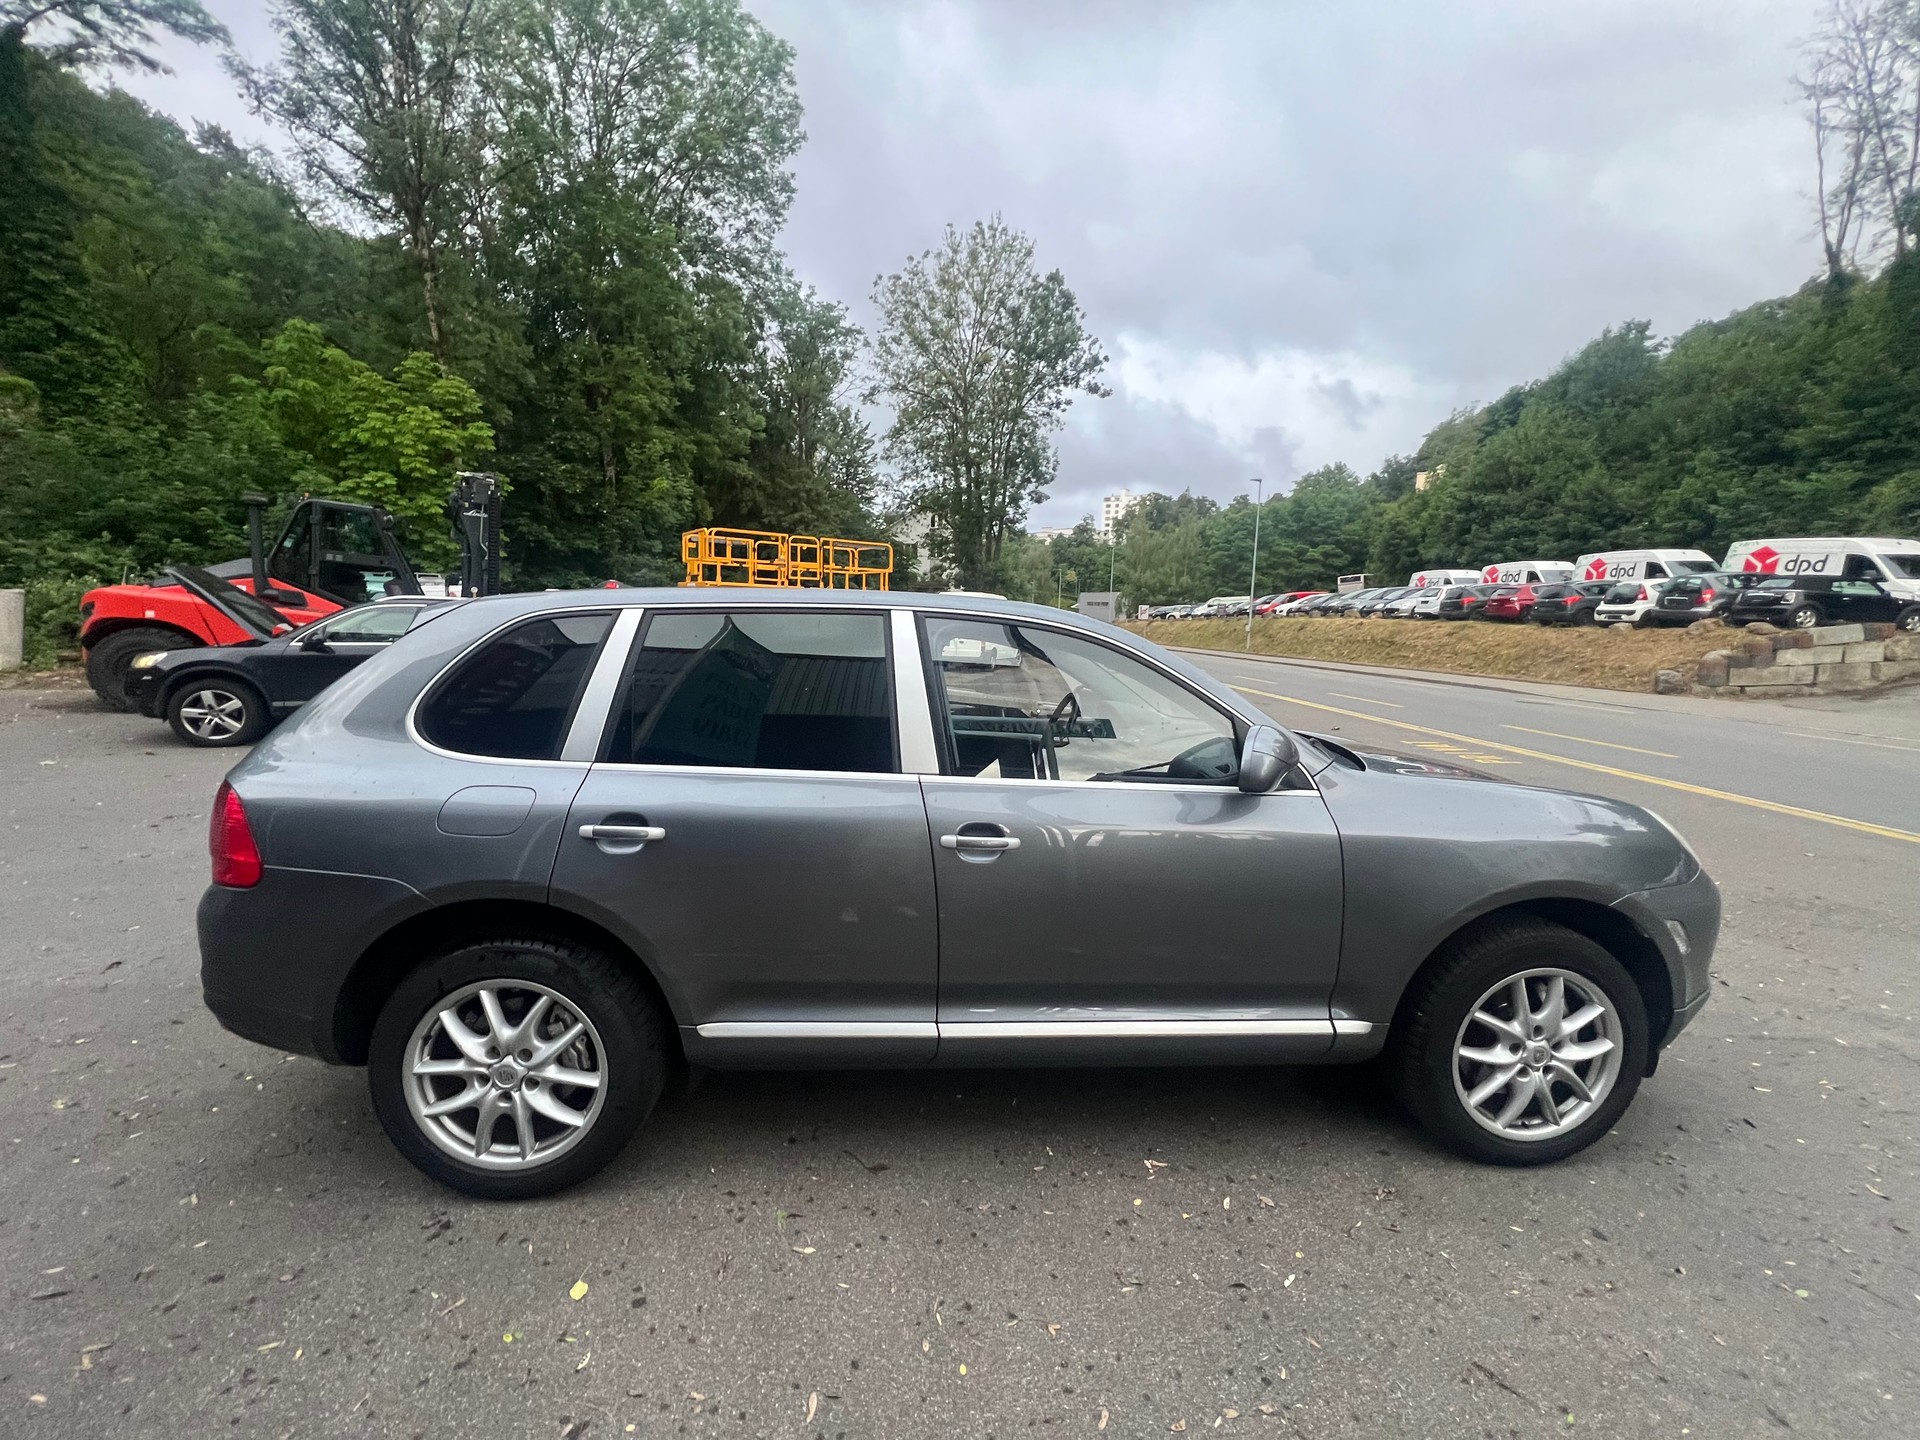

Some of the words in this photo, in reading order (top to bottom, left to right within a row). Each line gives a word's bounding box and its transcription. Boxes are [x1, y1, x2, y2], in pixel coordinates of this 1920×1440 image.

[1609, 563, 1637, 580] dpd
[1785, 554, 1829, 575] dpd
[1501, 569, 1522, 583] dpd
